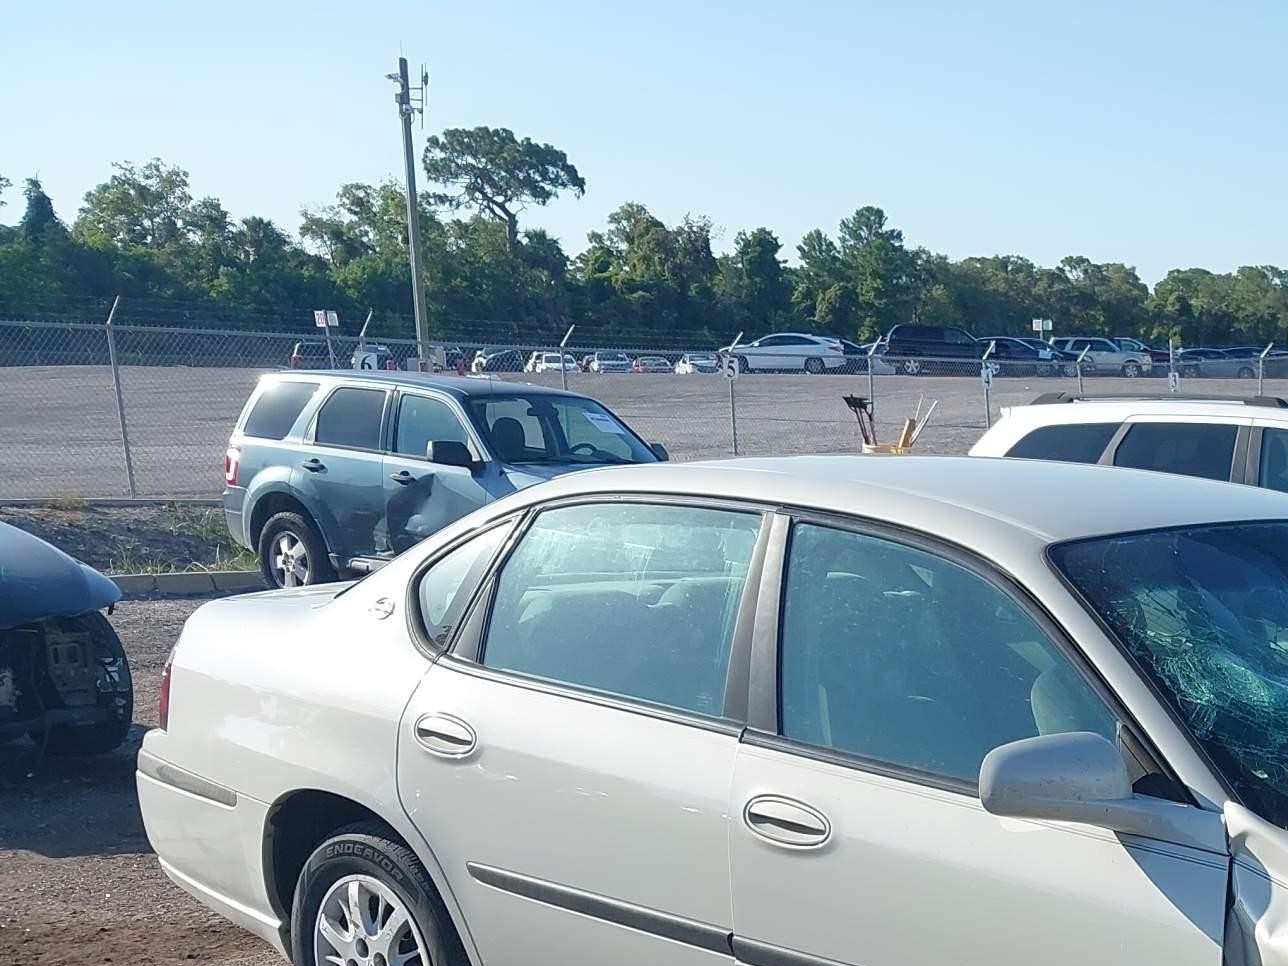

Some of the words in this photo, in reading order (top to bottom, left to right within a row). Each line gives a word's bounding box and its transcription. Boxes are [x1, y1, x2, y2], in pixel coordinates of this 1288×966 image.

[360, 355, 373, 370] 6
[727, 360, 736, 378] 5
[325, 842, 404, 881] ENDEAVOR
